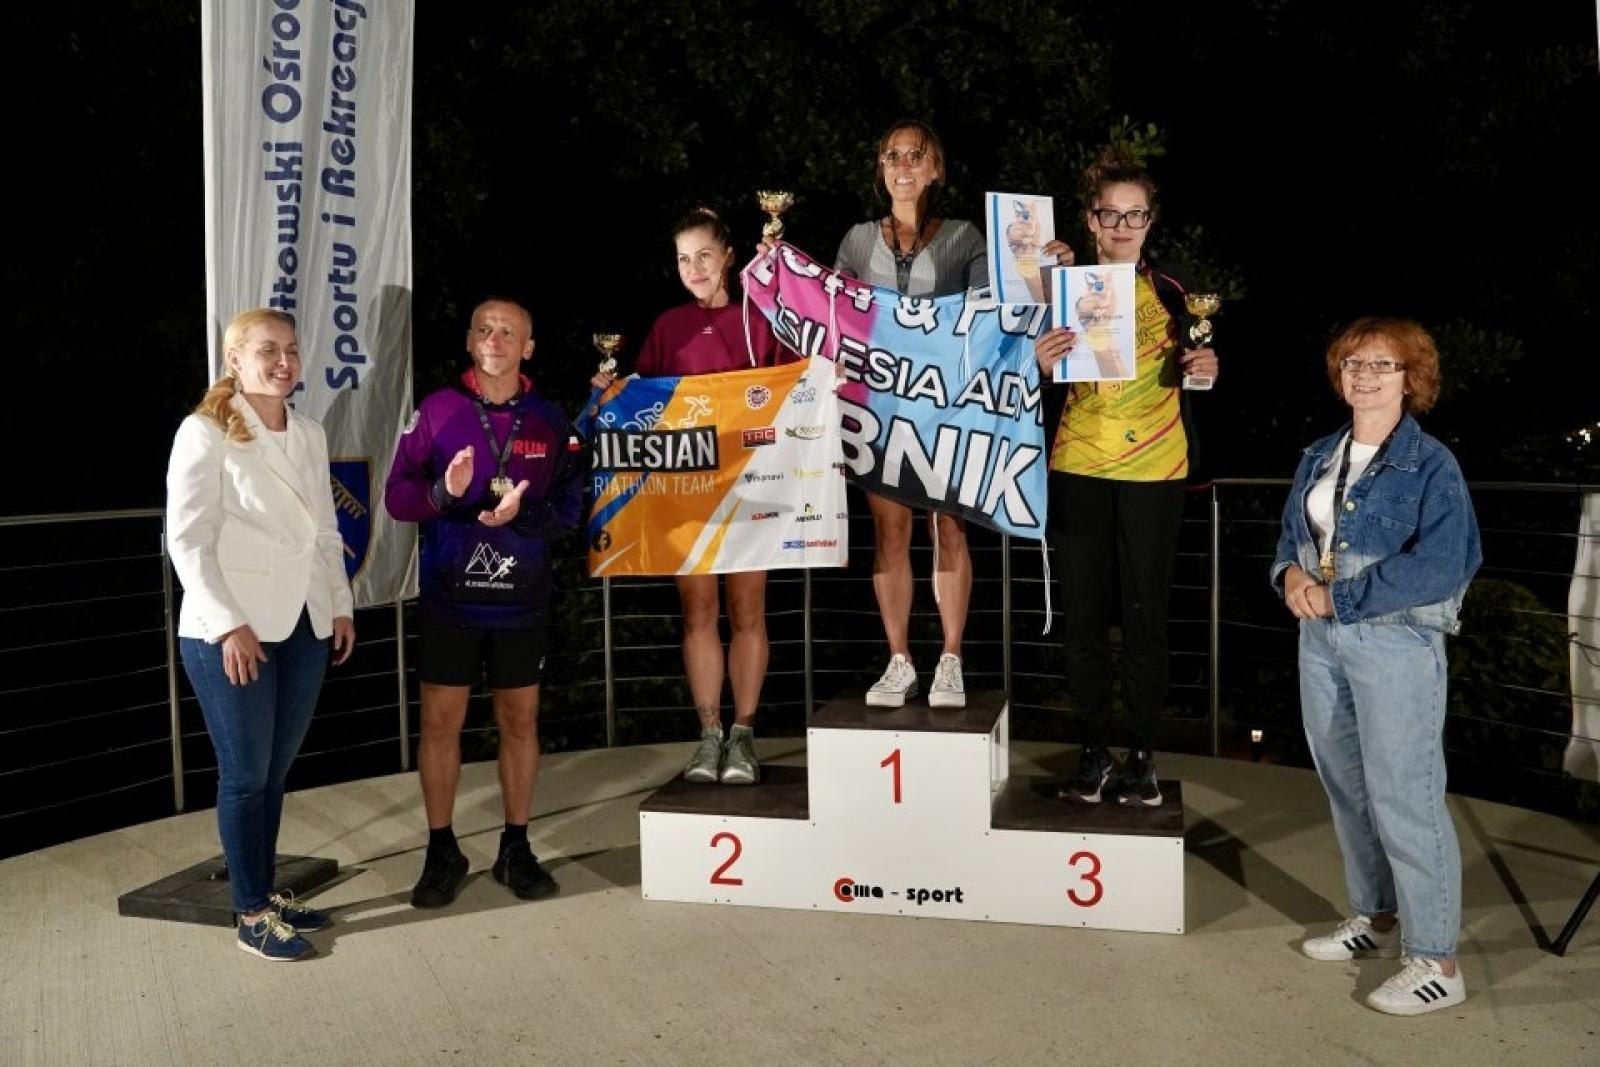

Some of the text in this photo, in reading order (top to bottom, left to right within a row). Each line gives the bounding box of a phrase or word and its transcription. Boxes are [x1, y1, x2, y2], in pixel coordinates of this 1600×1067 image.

[262, 0, 302, 311] łtowski Ośro
[321, 0, 368, 391] Sportu i Rekreacj
[594, 474, 715, 497] RIATHLON TEAM
[836, 398, 1042, 527] BNIK
[879, 748, 902, 804] 1
[709, 831, 744, 886] 2
[1066, 851, 1104, 907] 3
[906, 887, 964, 906] sport
